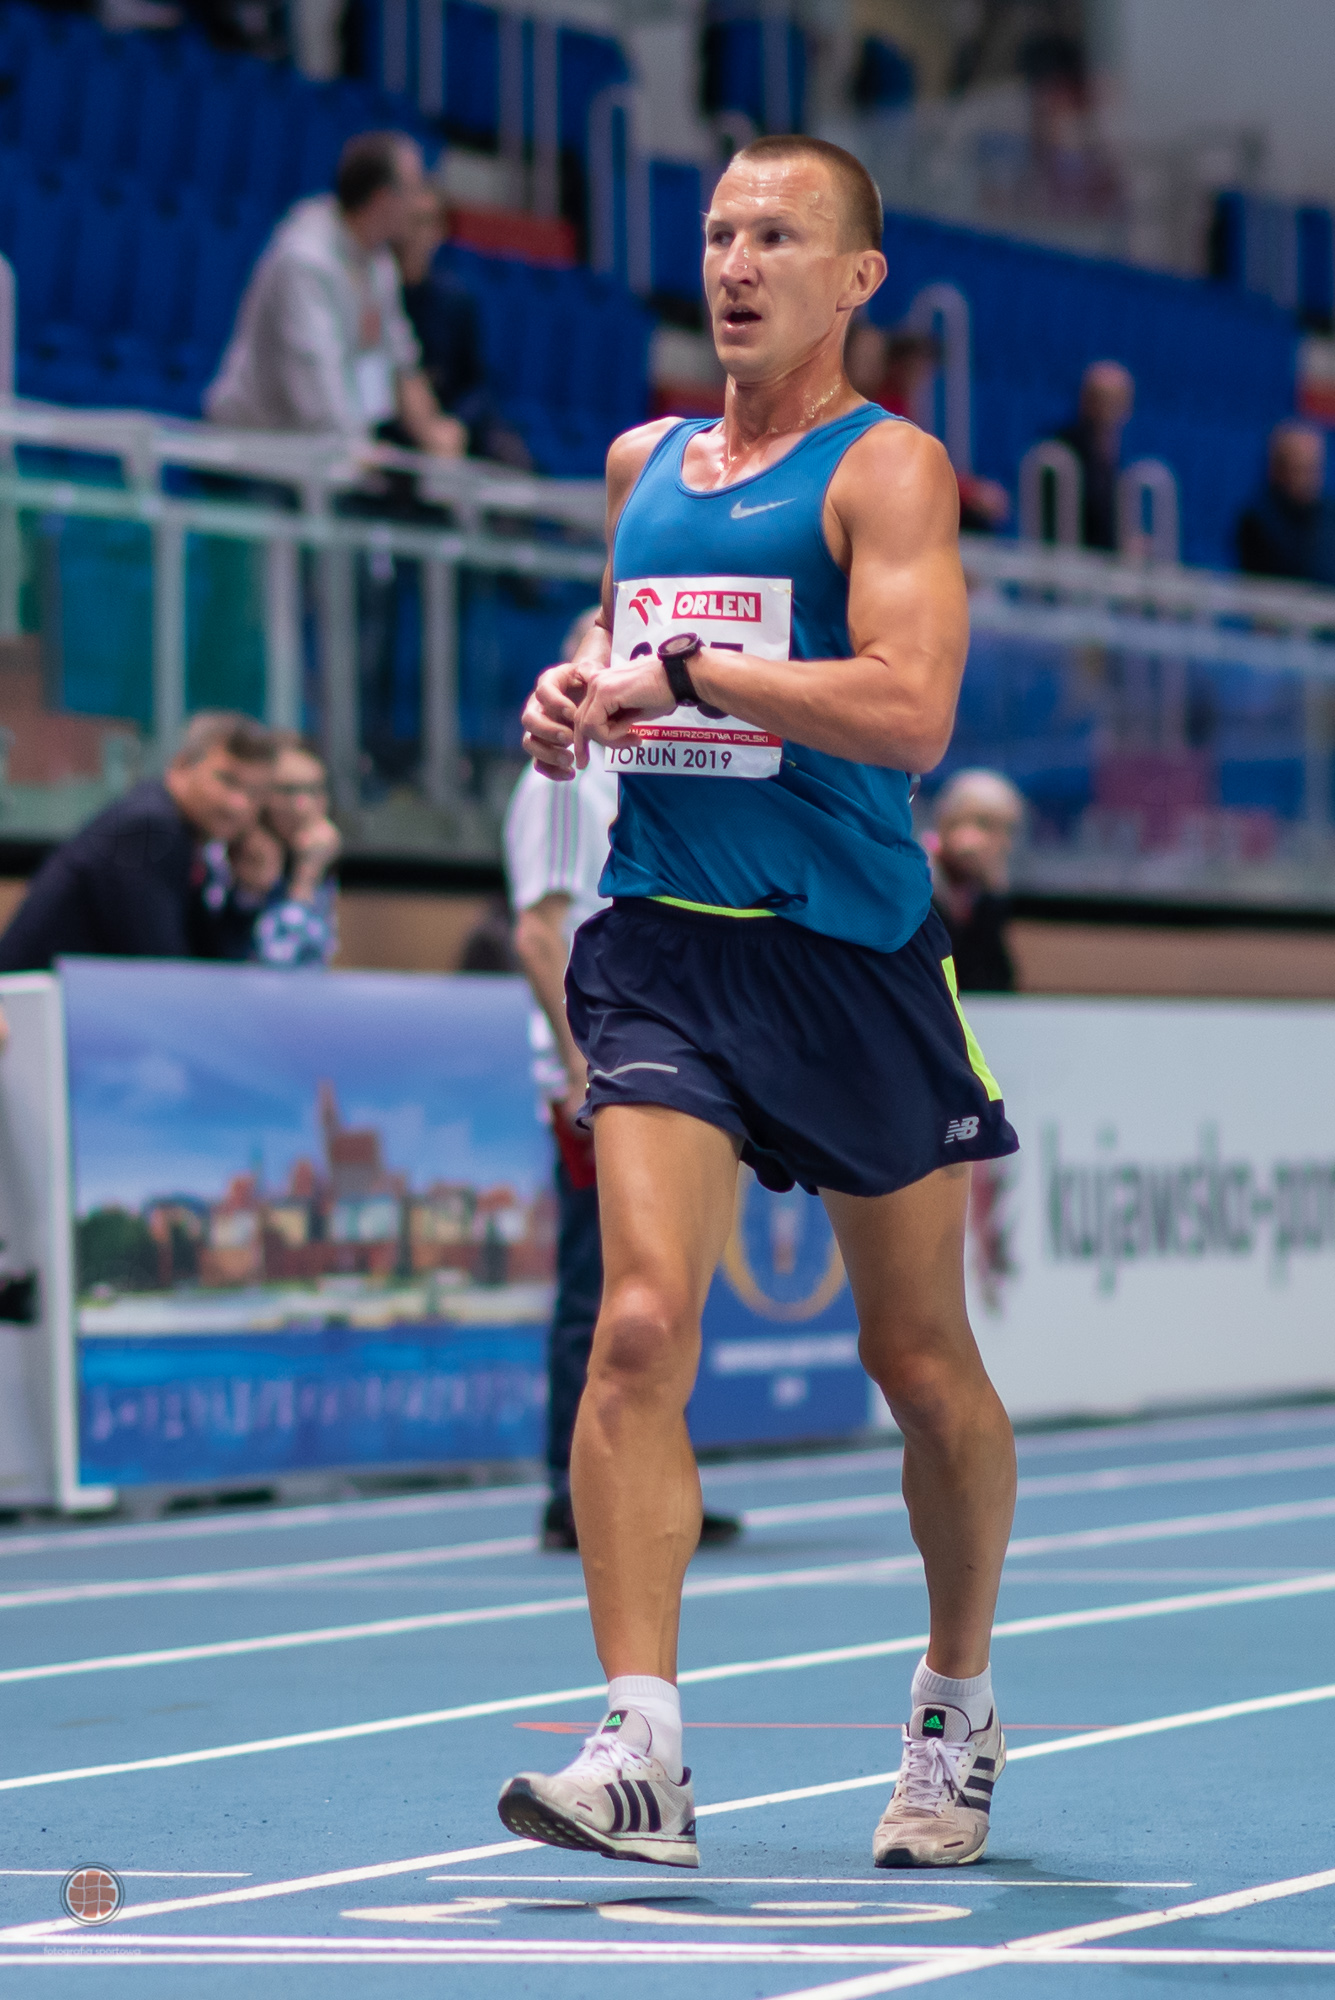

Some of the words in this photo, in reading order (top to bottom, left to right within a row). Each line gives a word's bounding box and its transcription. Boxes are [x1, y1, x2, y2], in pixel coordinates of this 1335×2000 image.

[676, 594, 756, 618] ORLEN
[661, 729, 732, 741] MISTRZOSTWA
[733, 733, 769, 743] POLSKI
[683, 749, 733, 770] 2019
